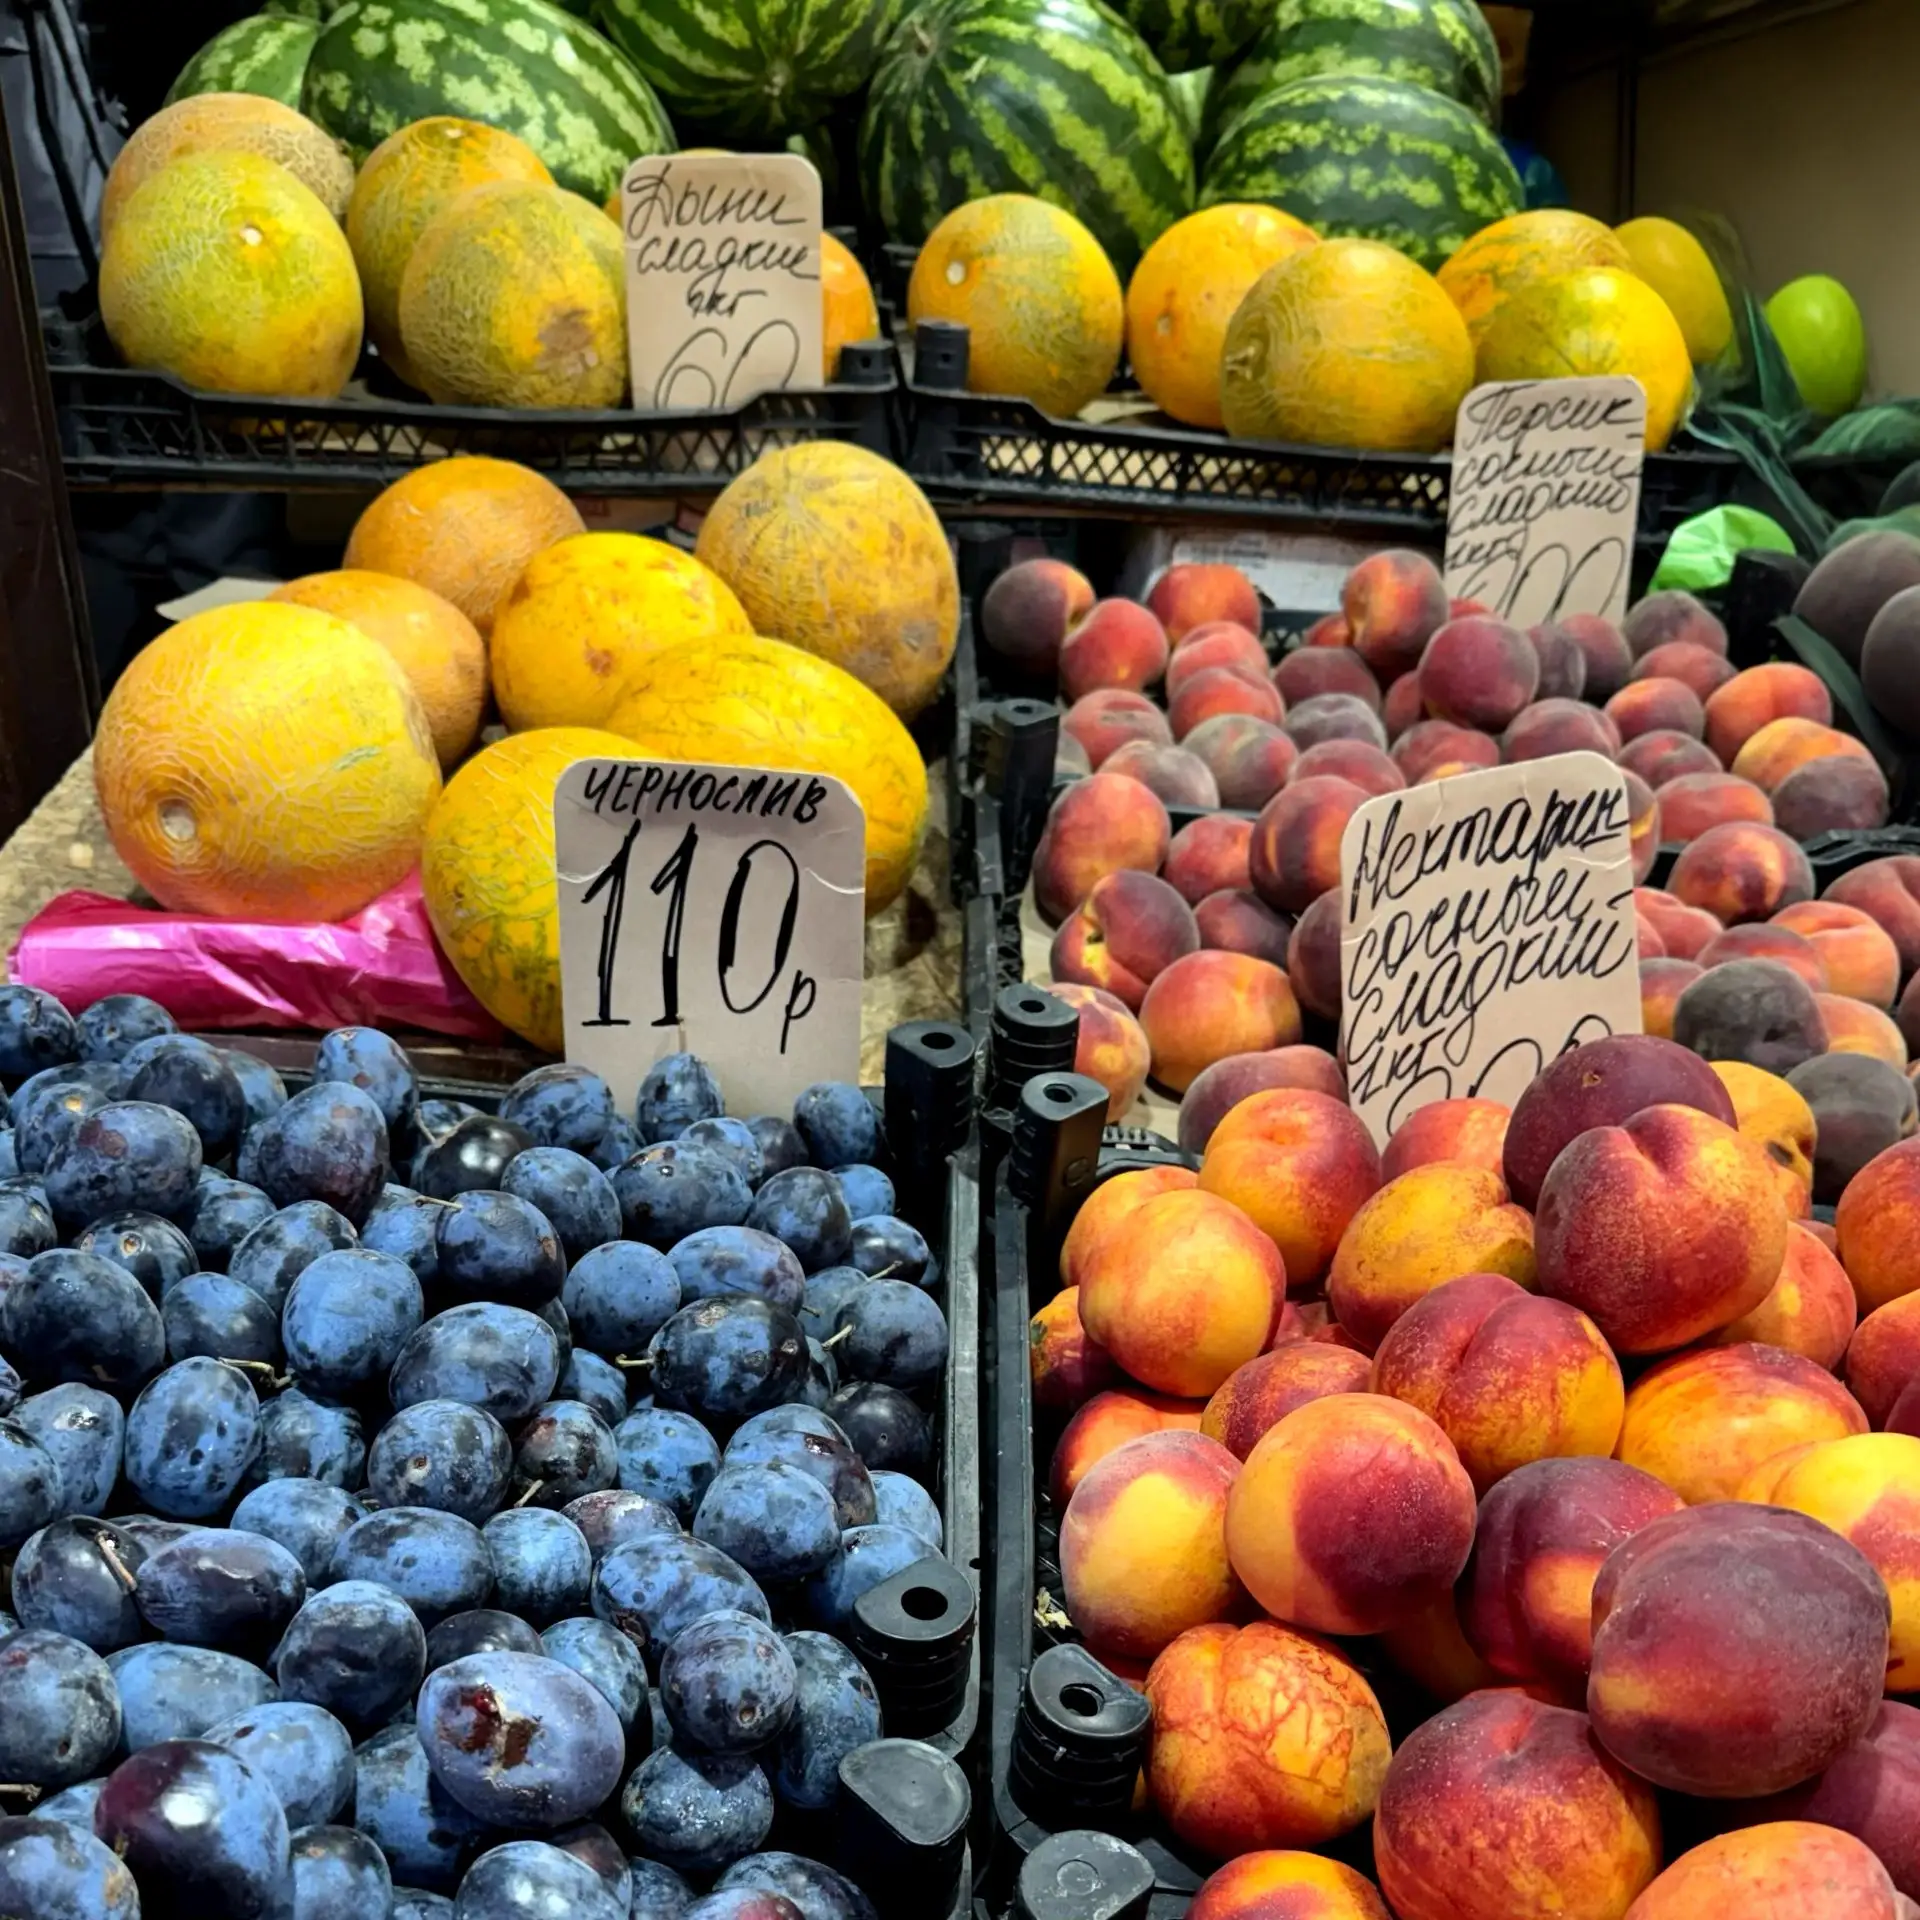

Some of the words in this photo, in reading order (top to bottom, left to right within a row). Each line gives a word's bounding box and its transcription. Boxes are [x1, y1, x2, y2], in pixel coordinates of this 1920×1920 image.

[627, 162, 807, 240] Дыни
[1461, 383, 1644, 456] Персик
[583, 764, 828, 824] ЧЕРНОСЛИВ
[1349, 788, 1631, 925] Нектарин
